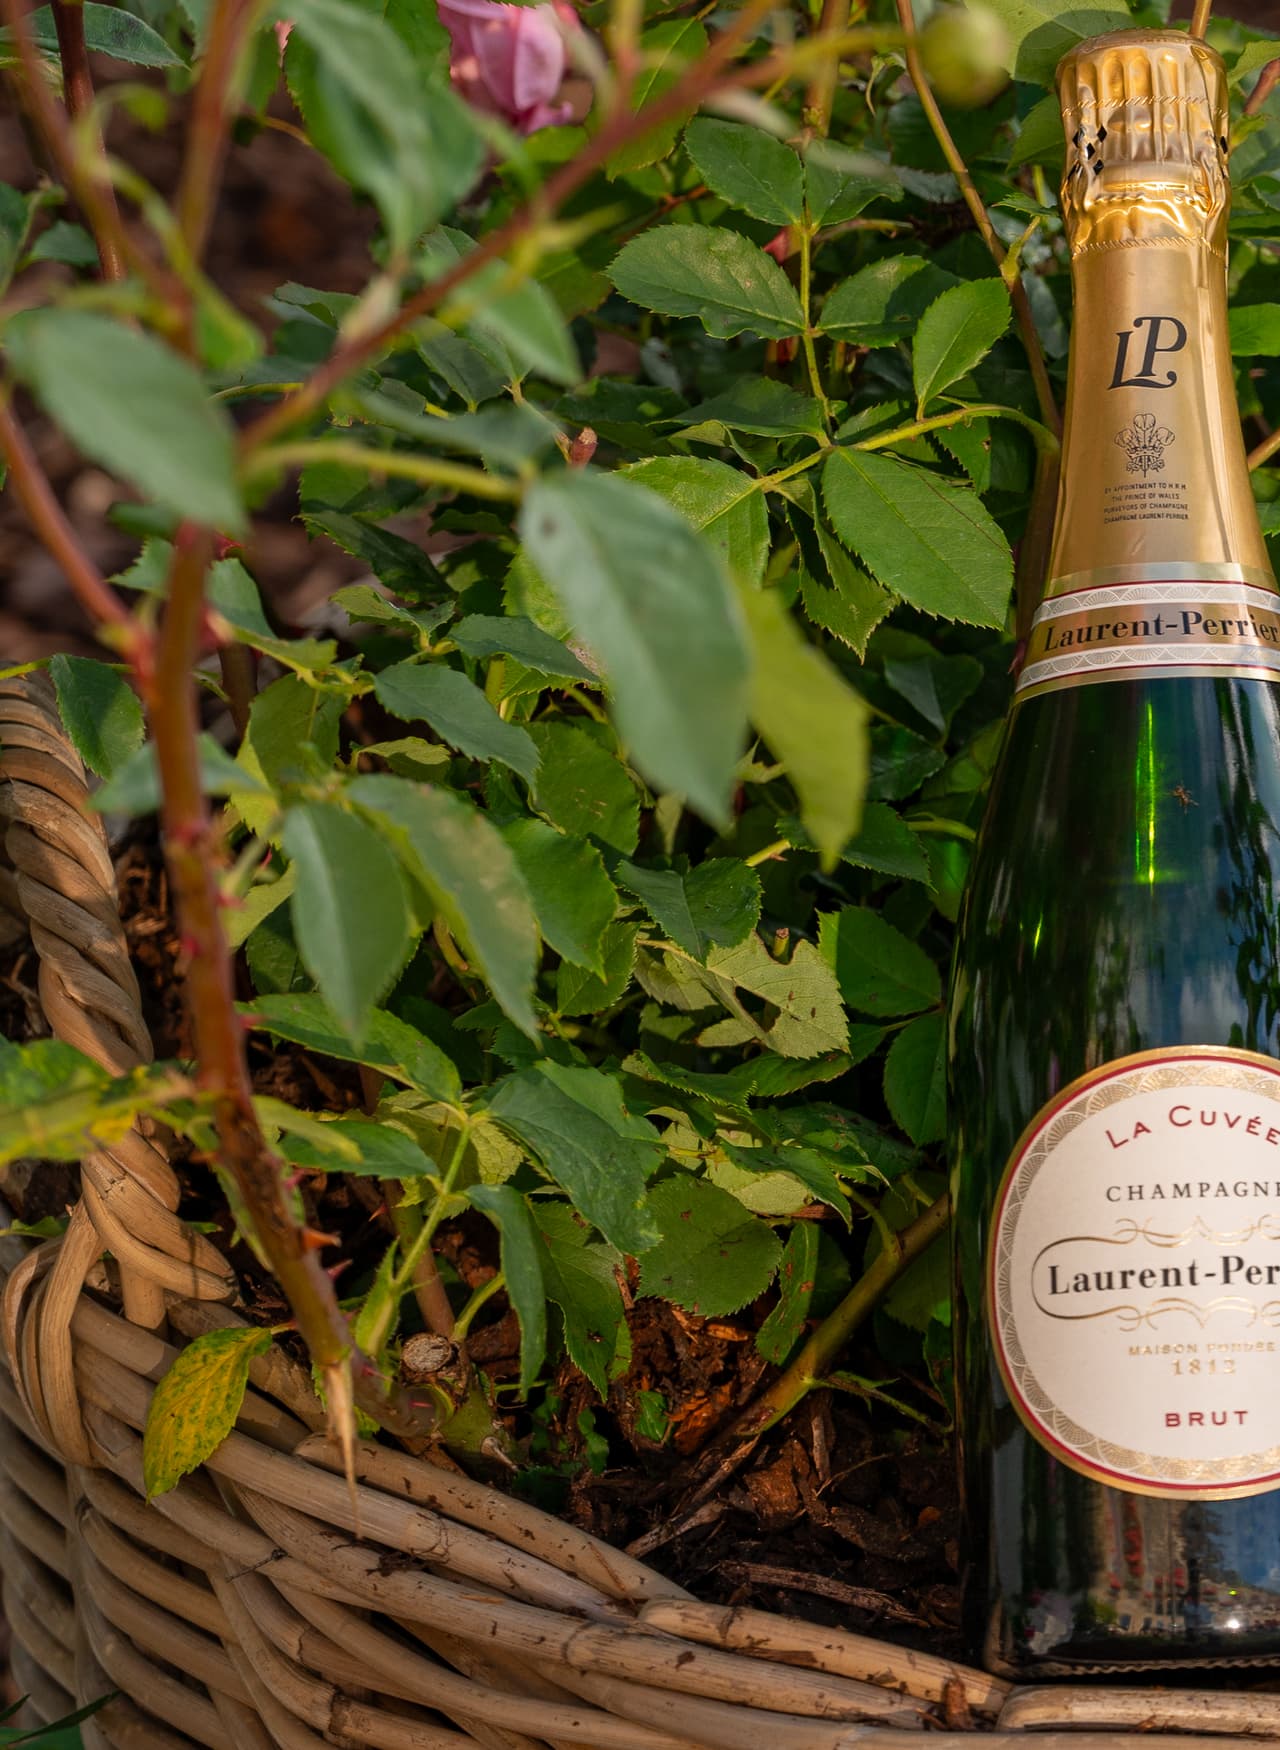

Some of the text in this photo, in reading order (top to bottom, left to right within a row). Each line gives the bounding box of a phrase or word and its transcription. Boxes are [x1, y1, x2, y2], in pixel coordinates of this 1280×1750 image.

[1108, 316, 1187, 390] LP
[1045, 611, 1279, 652] Laurent-Perrier
[1106, 1121, 1152, 1149] LA
[1128, 1344, 1197, 1355] MAISON
[1164, 1410, 1249, 1427] BRUT
